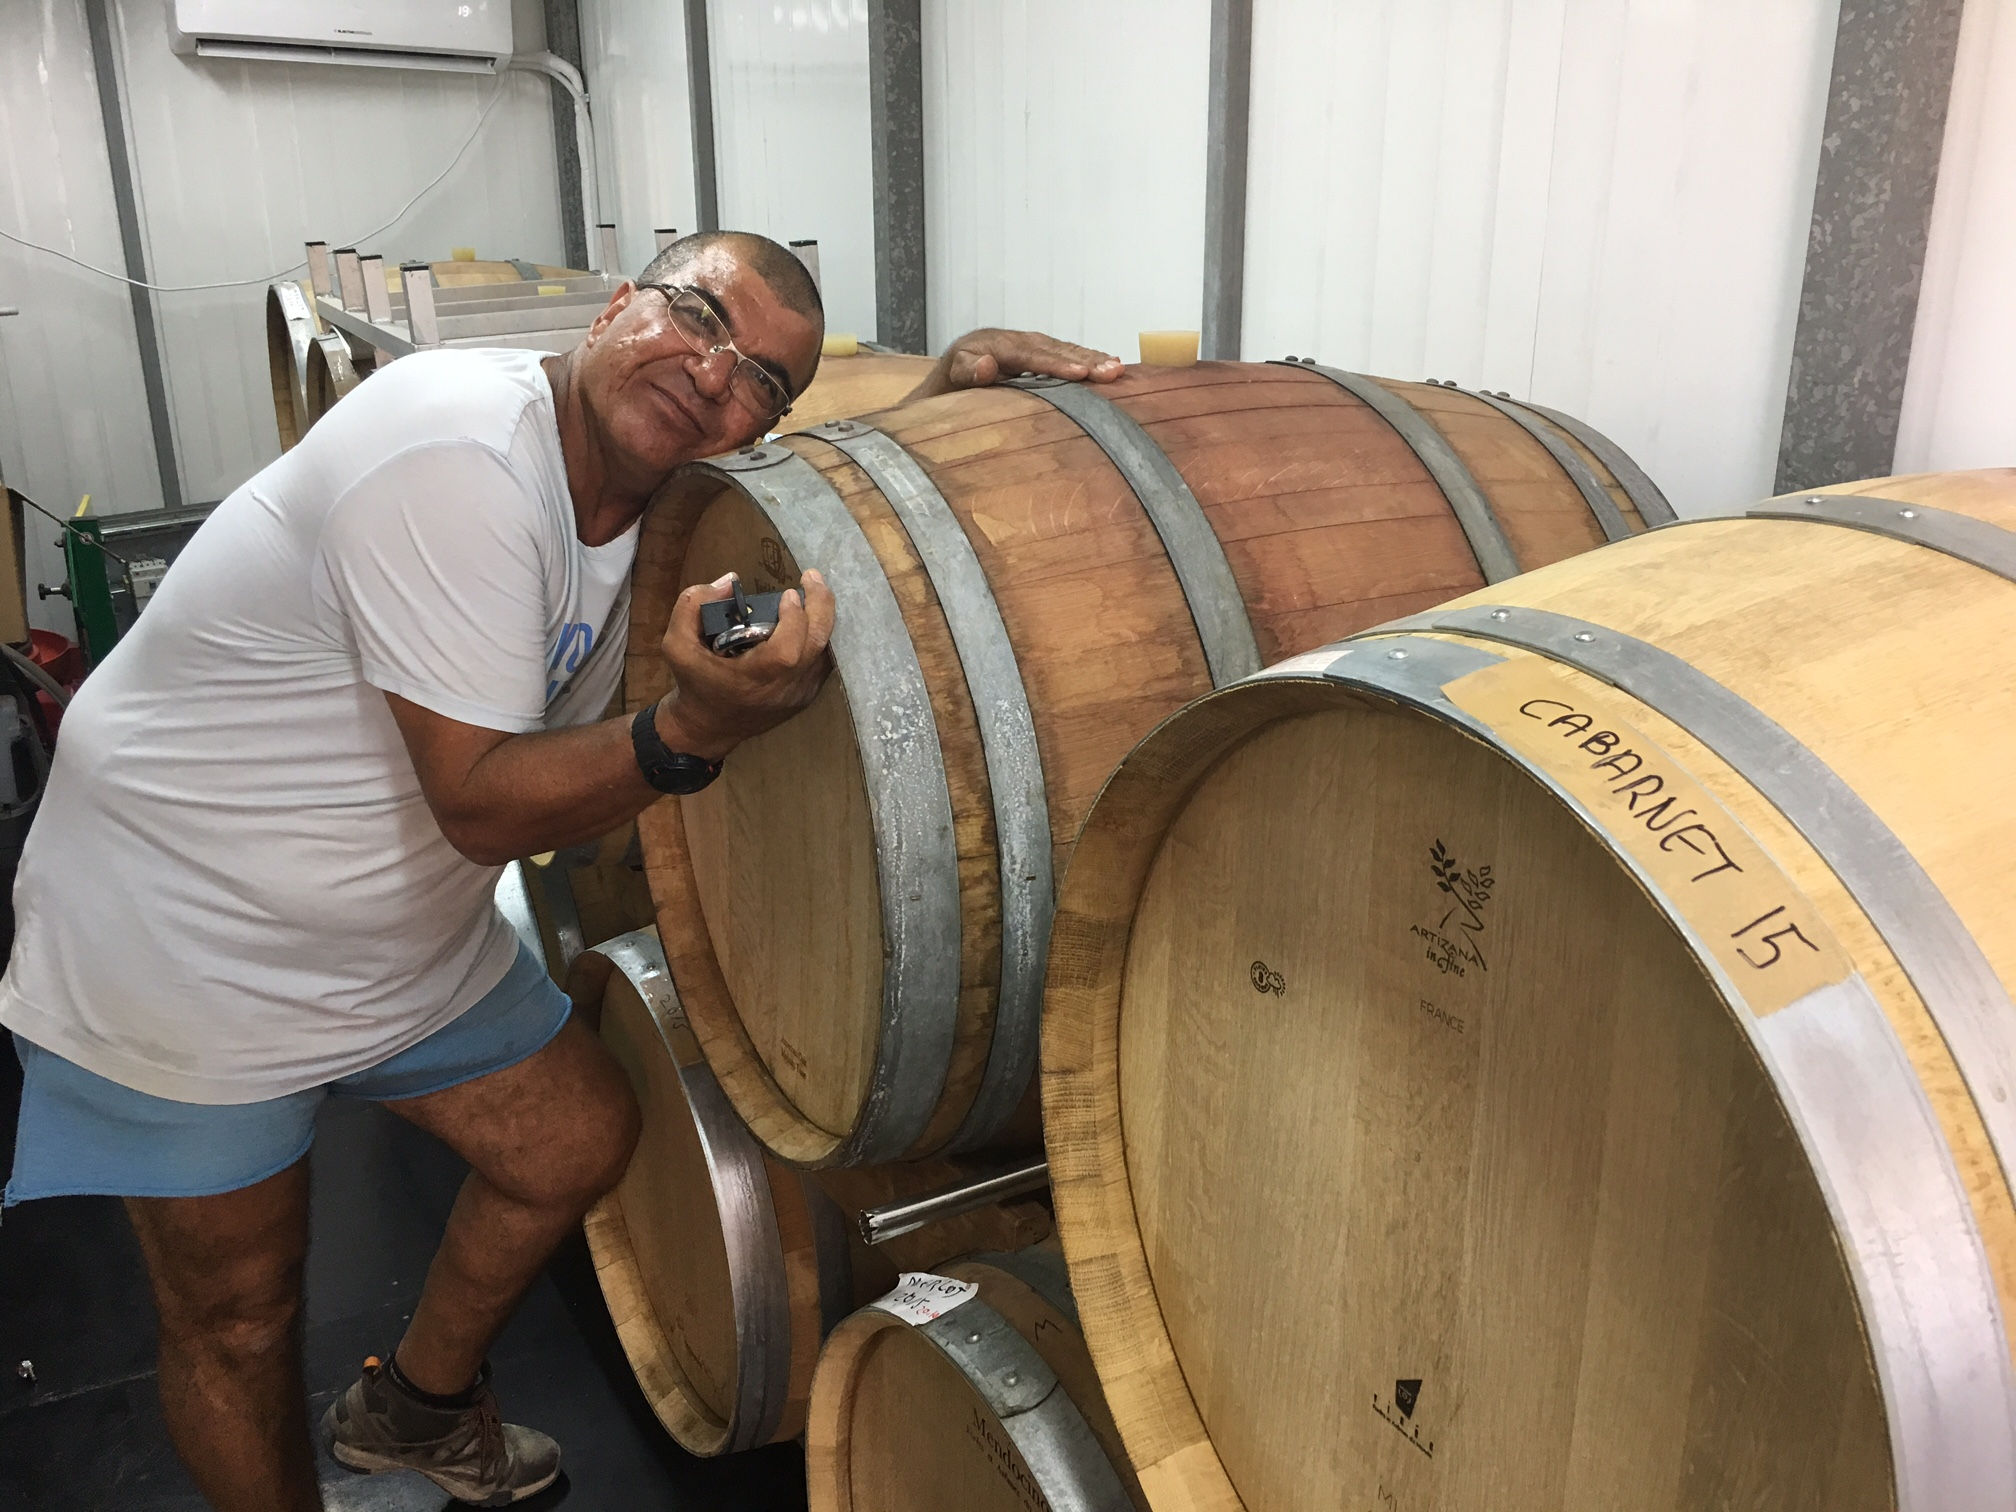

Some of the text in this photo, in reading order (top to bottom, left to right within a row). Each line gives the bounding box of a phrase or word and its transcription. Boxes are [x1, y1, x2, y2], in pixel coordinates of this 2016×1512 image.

[1519, 699, 1820, 970] CABARNET 15
[1420, 1000, 1464, 1034] FRANCE
[973, 1410, 1052, 1512] Mendocino
